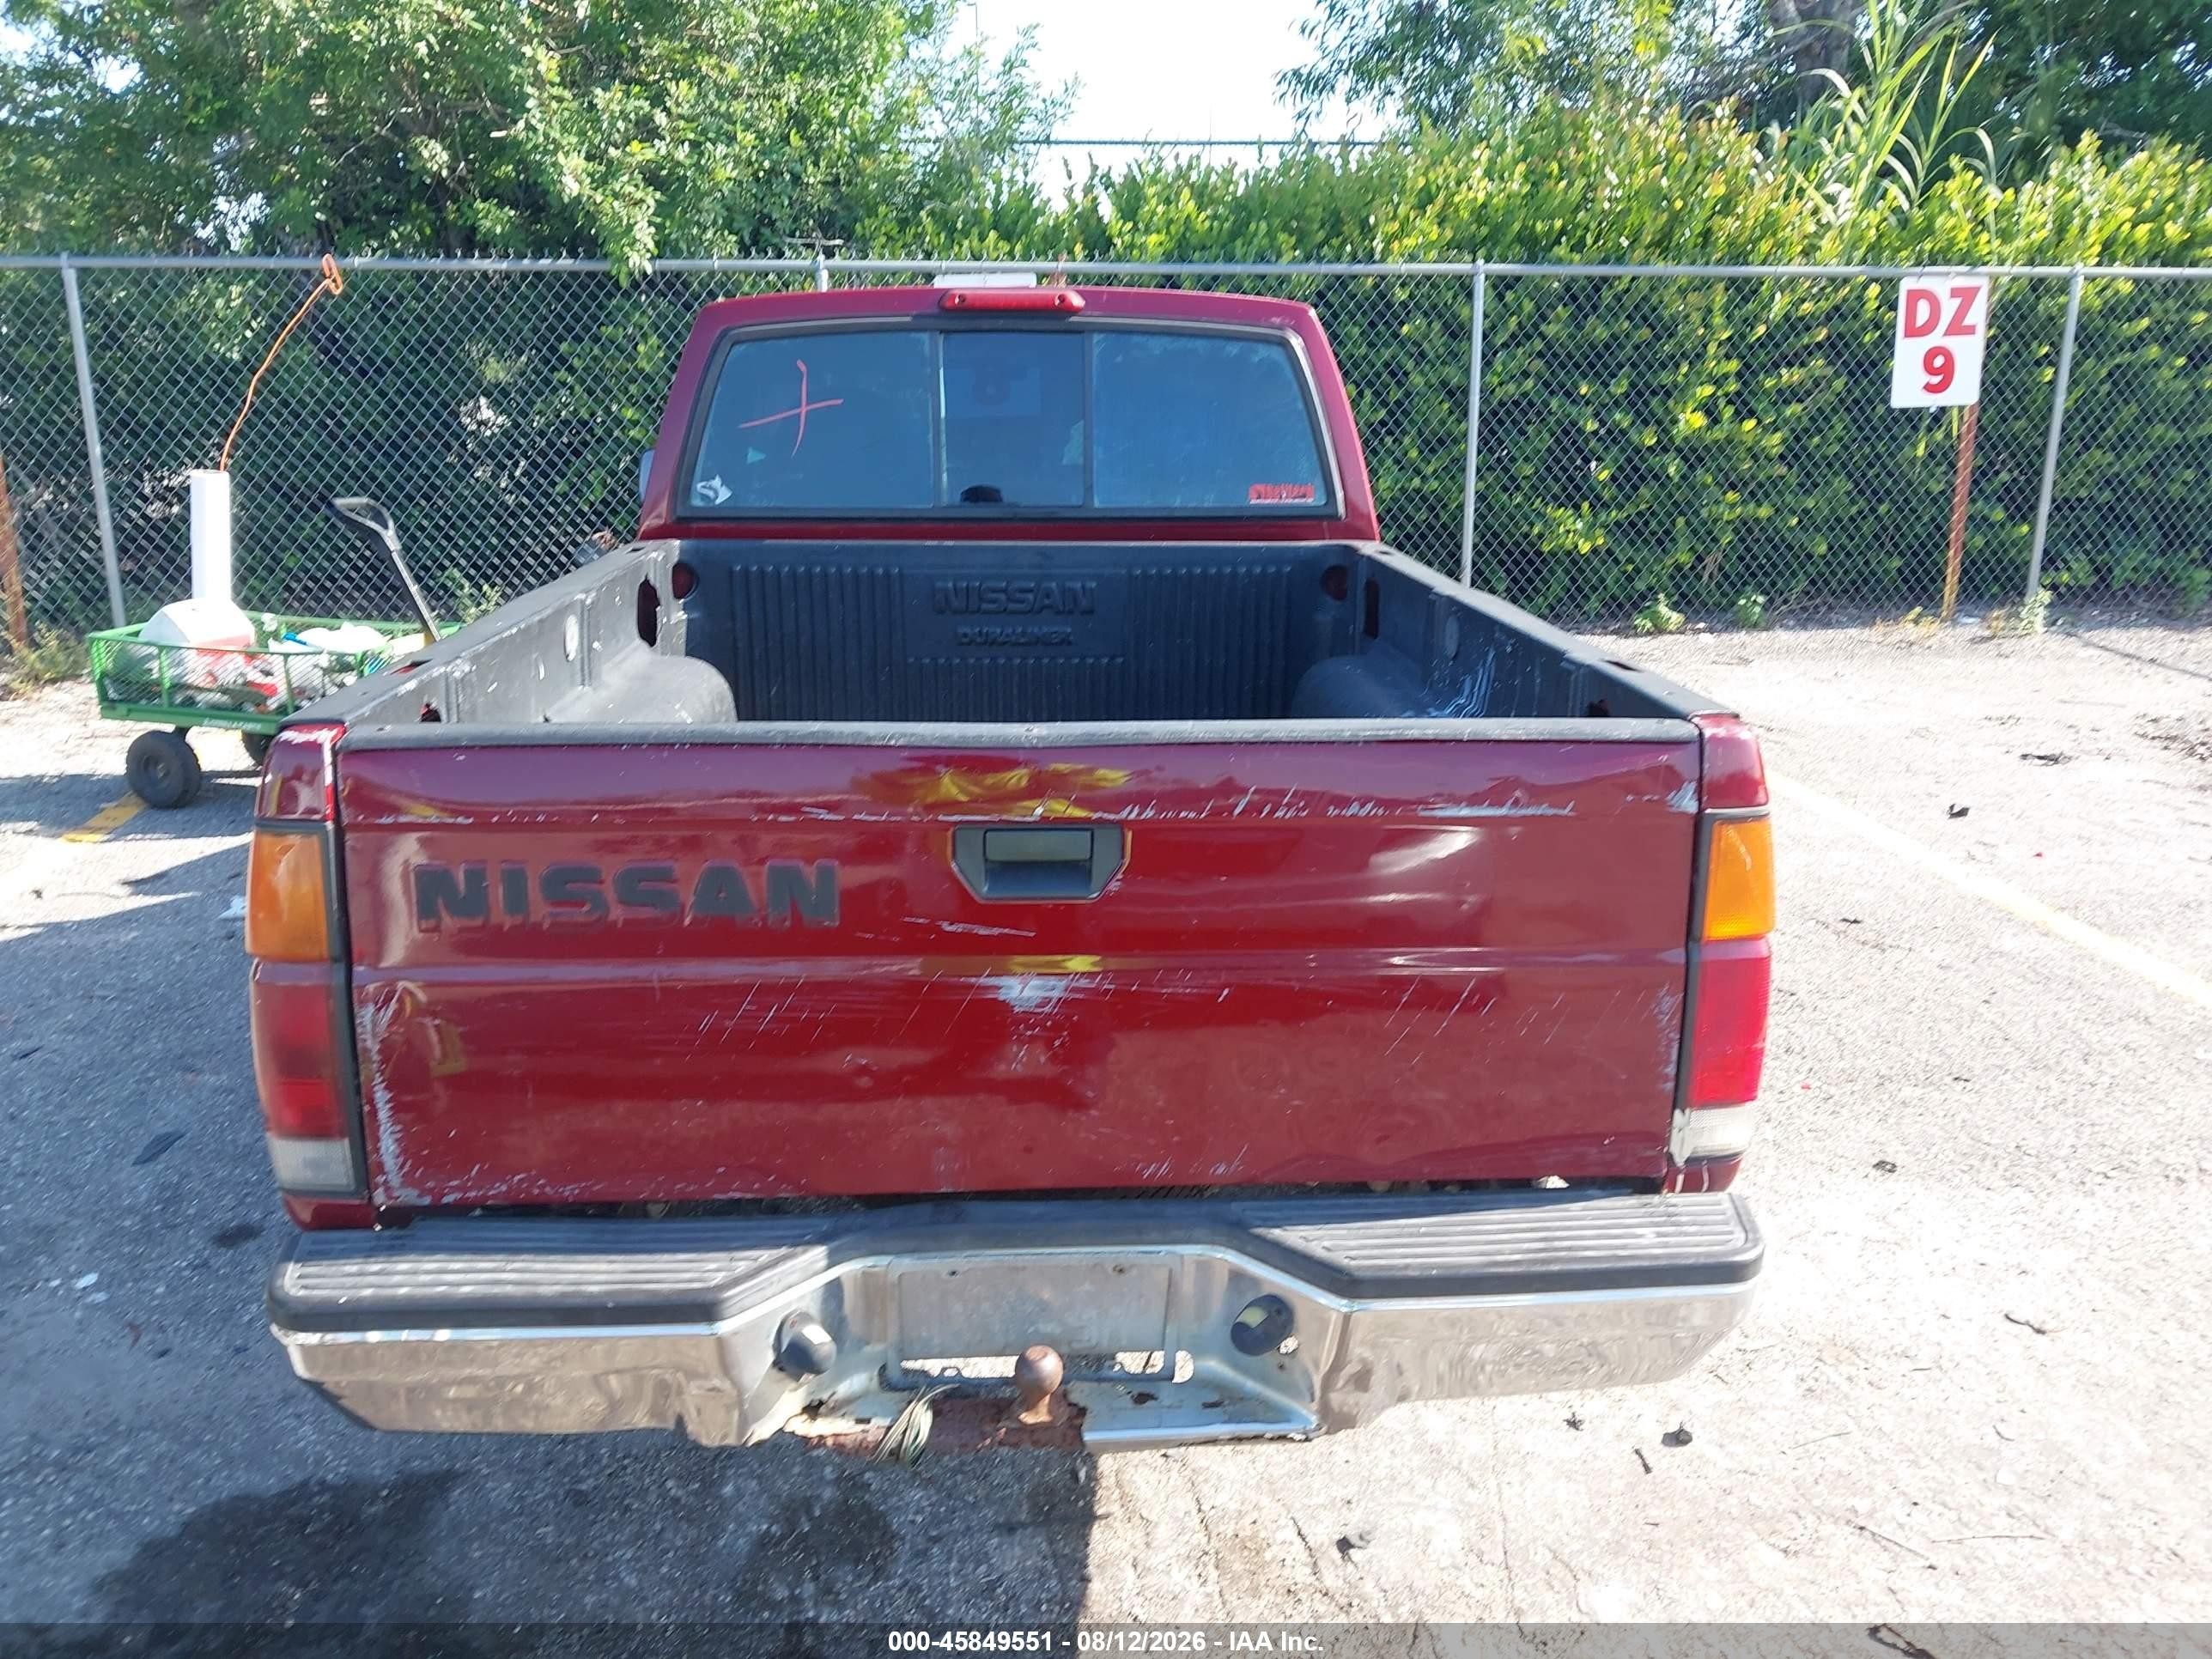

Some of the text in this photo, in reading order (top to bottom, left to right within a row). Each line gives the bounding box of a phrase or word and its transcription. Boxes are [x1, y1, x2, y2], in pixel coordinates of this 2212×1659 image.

[1904, 285, 1982, 338] DZ
[1922, 346, 1955, 394] 9
[933, 580, 1097, 615] NISSAN
[413, 860, 841, 932] NISSAN
